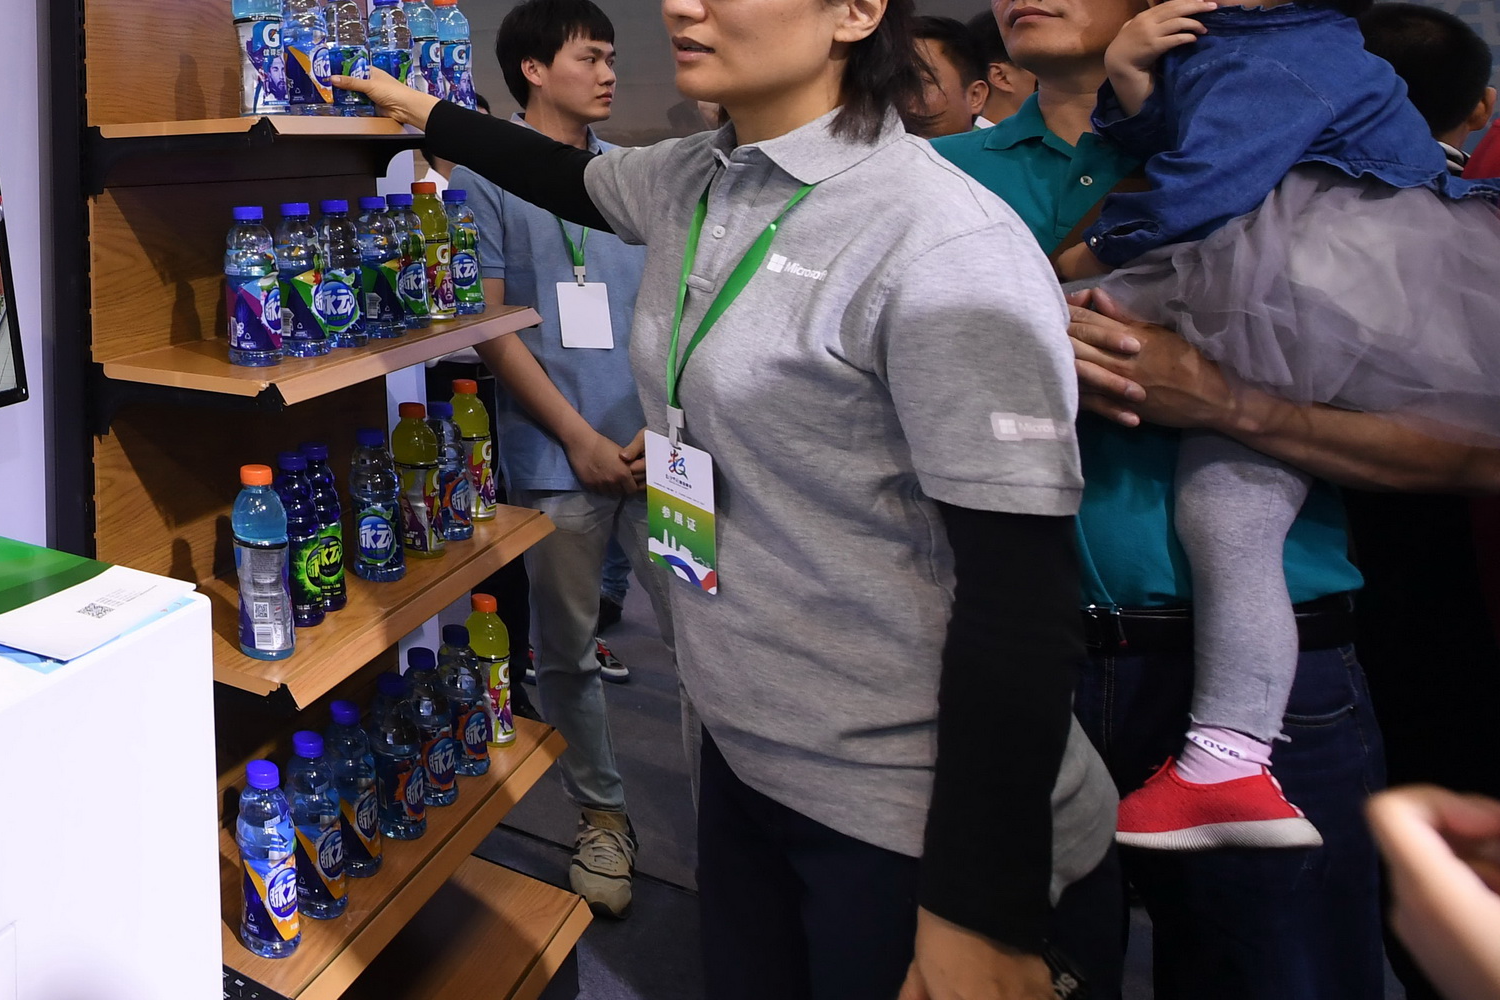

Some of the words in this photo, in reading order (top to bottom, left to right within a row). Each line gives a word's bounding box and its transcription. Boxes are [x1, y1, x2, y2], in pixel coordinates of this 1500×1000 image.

[784, 261, 828, 281] Microsoft
[661, 505, 697, 533] 参展证
